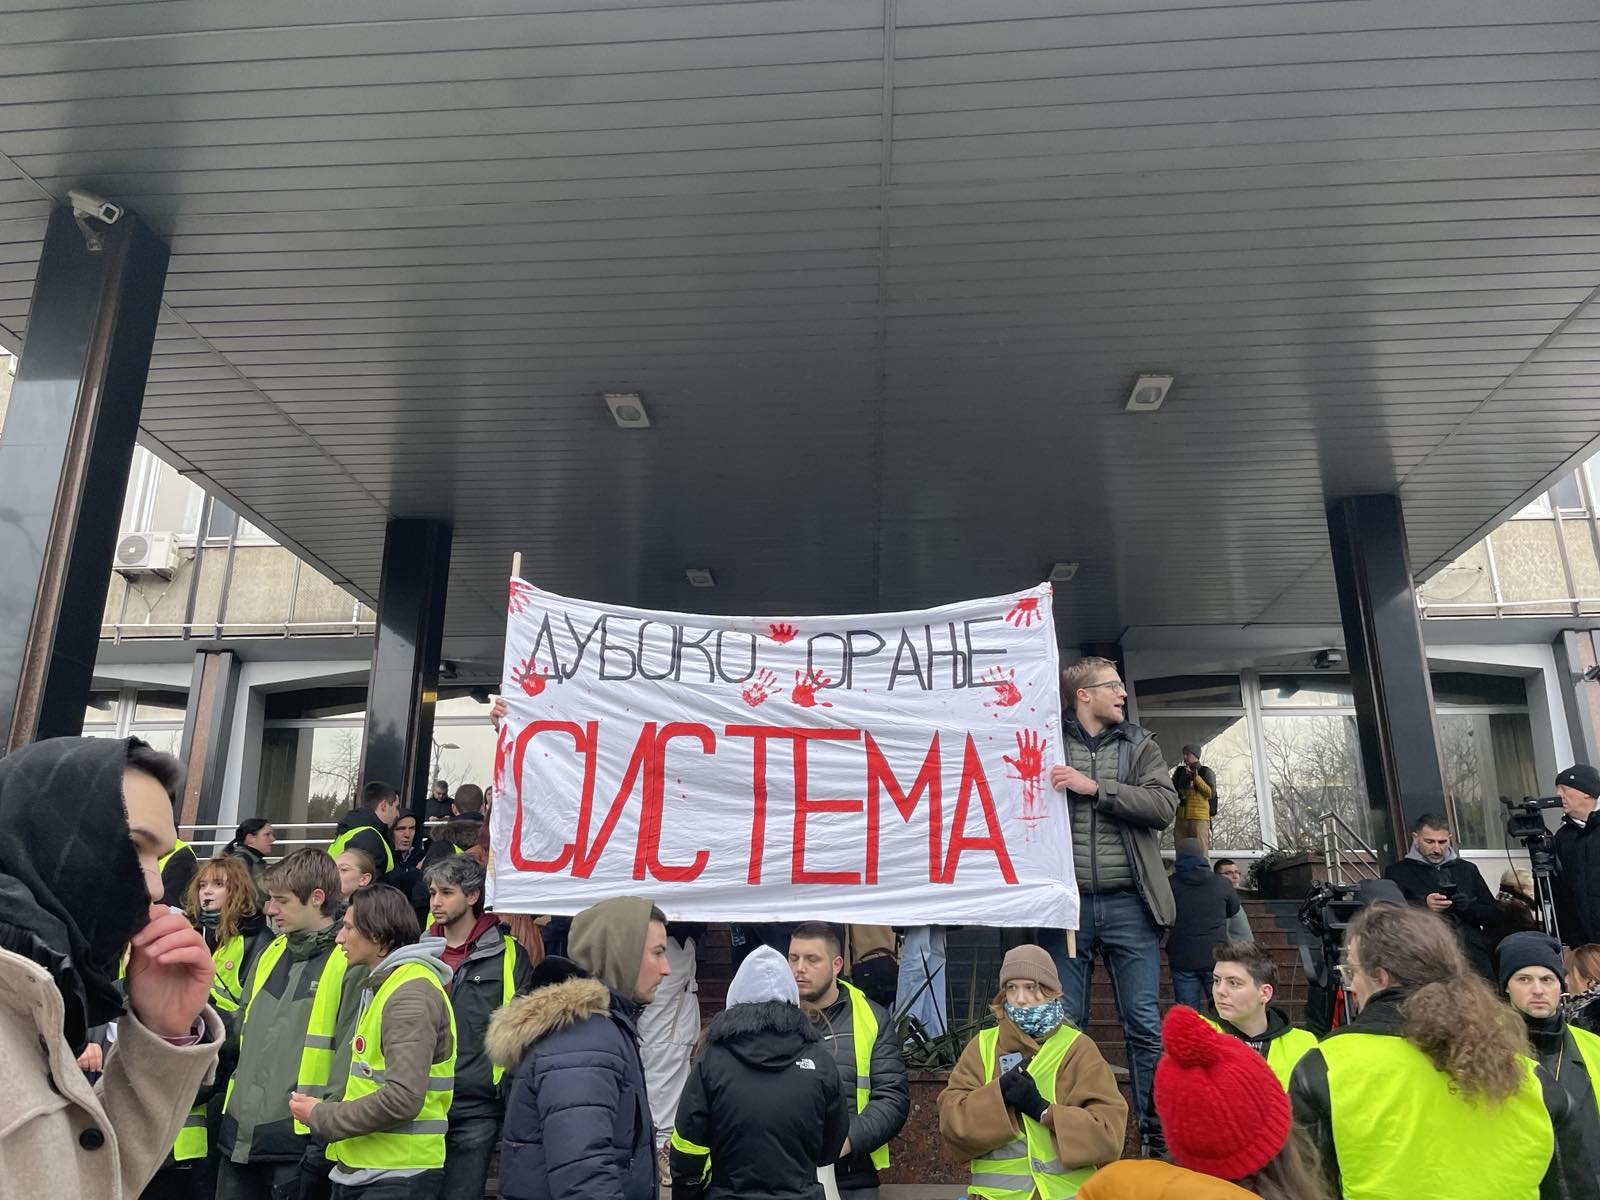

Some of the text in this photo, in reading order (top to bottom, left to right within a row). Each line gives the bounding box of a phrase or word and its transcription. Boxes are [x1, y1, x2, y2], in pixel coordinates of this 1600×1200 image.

[519, 611, 1008, 690] ДУБОКО ОРАЊЕ
[510, 720, 1019, 885] СИСТЕМА
